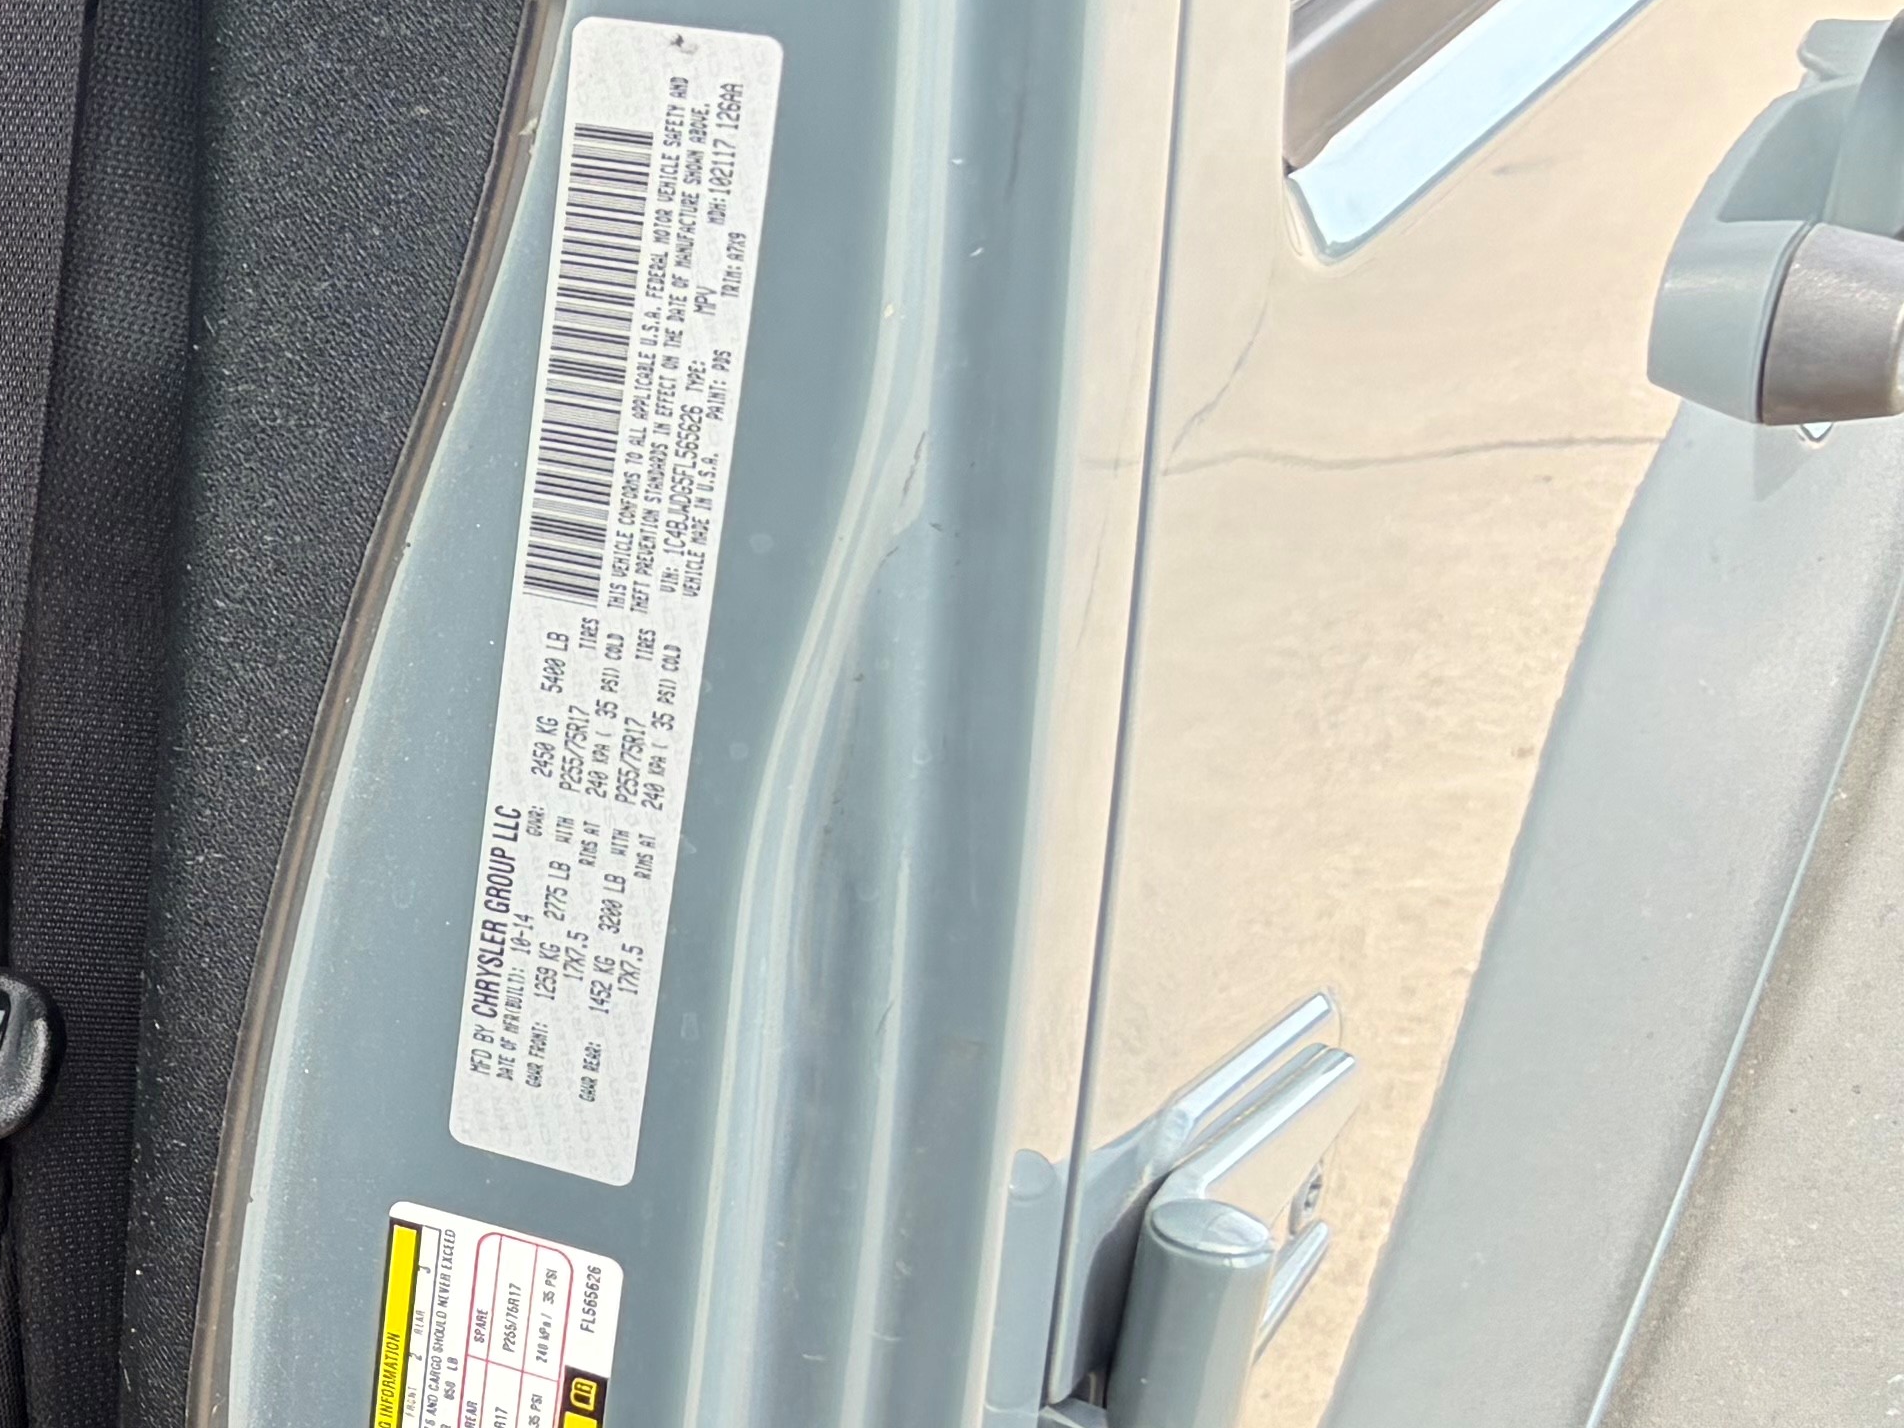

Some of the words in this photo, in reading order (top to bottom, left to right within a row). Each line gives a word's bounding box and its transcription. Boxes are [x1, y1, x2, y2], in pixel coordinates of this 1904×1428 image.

[668, 75, 690, 99] AND
[687, 101, 711, 144] ABOVE.
[715, 82, 745, 130] 126AA
[662, 103, 686, 147] SAFETY
[655, 151, 680, 203] VEHICLE
[682, 148, 705, 186] SHOWN
[651, 207, 673, 244] MOTOR
[672, 190, 700, 269] MANUFACTURE
[725, 231, 747, 261] A7X9
[644, 249, 668, 299] FEDERAL
[669, 273, 690, 289] OF
[665, 293, 687, 322] DATE
[692, 284, 719, 315] MPV
[638, 303, 662, 346] U.S.A.
[662, 326, 683, 349] THE
[659, 354, 679, 370] ON
[684, 358, 706, 393] TYPE:
[629, 350, 656, 420] APPLICABLE
[654, 374, 677, 417] EFFECT
[704, 378, 728, 421] PAINT:
[626, 424, 647, 446] ALL
[651, 421, 671, 436] IN
[624, 450, 643, 465] TO
[643, 441, 668, 504] STANDARDS
[695, 450, 718, 492] U.S.A.
[616, 470, 641, 526] CONFORMS
[693, 495, 712, 511] IN
[634, 507, 660, 576] PREVENTION
[688, 515, 710, 545] MADE
[610, 530, 634, 579] VEHICLE
[659, 565, 679, 593] VIN:
[682, 549, 705, 598] VEHICLE
[606, 582, 627, 610] THIS
[629, 580, 651, 614] THEFT
[545, 630, 569, 651] LB
[578, 616, 599, 650] TIRES
[604, 631, 624, 661] COLD
[634, 627, 656, 661] TIRES
[660, 642, 681, 672] COLD
[540, 655, 566, 694] 5400
[535, 714, 559, 736] KG
[594, 698, 618, 720] 35
[650, 710, 675, 732] 35
[530, 740, 556, 778] 2450
[558, 703, 590, 792] P255/75R17
[614, 715, 646, 804] P255/75R17
[584, 768, 609, 798] 240
[640, 780, 665, 810] 240
[491, 803, 521, 842] LLC
[555, 815, 574, 843] WITH
[582, 819, 600, 836] AT
[578, 838, 598, 867] RIMS
[610, 827, 630, 856] WITH
[637, 832, 656, 848] AT
[483, 845, 516, 914] GROUP
[548, 859, 571, 881] LB
[633, 851, 654, 880] RIMS
[603, 872, 626, 894] LB
[543, 884, 568, 922] 2775
[598, 896, 623, 935] 3200
[509, 910, 534, 955] 10-14
[471, 916, 508, 1019] CHRYSLER
[538, 940, 561, 962] KG
[562, 928, 589, 982] 17X7.5
[593, 953, 616, 975] KG
[533, 965, 558, 1001] 1259
[616, 941, 645, 996] 17X7.5
[588, 978, 613, 1015] 1452
[472, 1023, 495, 1044] BY
[500, 1036, 518, 1051] OF
[528, 1020, 548, 1059] FRONT:
[469, 1046, 492, 1075] MFD
[496, 1053, 516, 1081] DATE
[582, 1039, 602, 1073] REAR:
[440, 1227, 456, 1270] EXCEED
[436, 1271, 451, 1308] NEVER
[544, 1267, 557, 1287] PSI
[542, 1288, 554, 1304] 35
[579, 1263, 602, 1333] FL565626
[432, 1309, 447, 1354] SHOULD
[473, 1307, 488, 1344] SPARE
[445, 1355, 458, 1371] LB
[535, 1342, 548, 1363] 240
[379, 1331, 400, 1418] INFORMATION
[428, 1354, 443, 1391] CARGO
[425, 1393, 438, 1416] AND
[529, 1392, 543, 1412] PSI
[527, 1412, 540, 1428] 35
